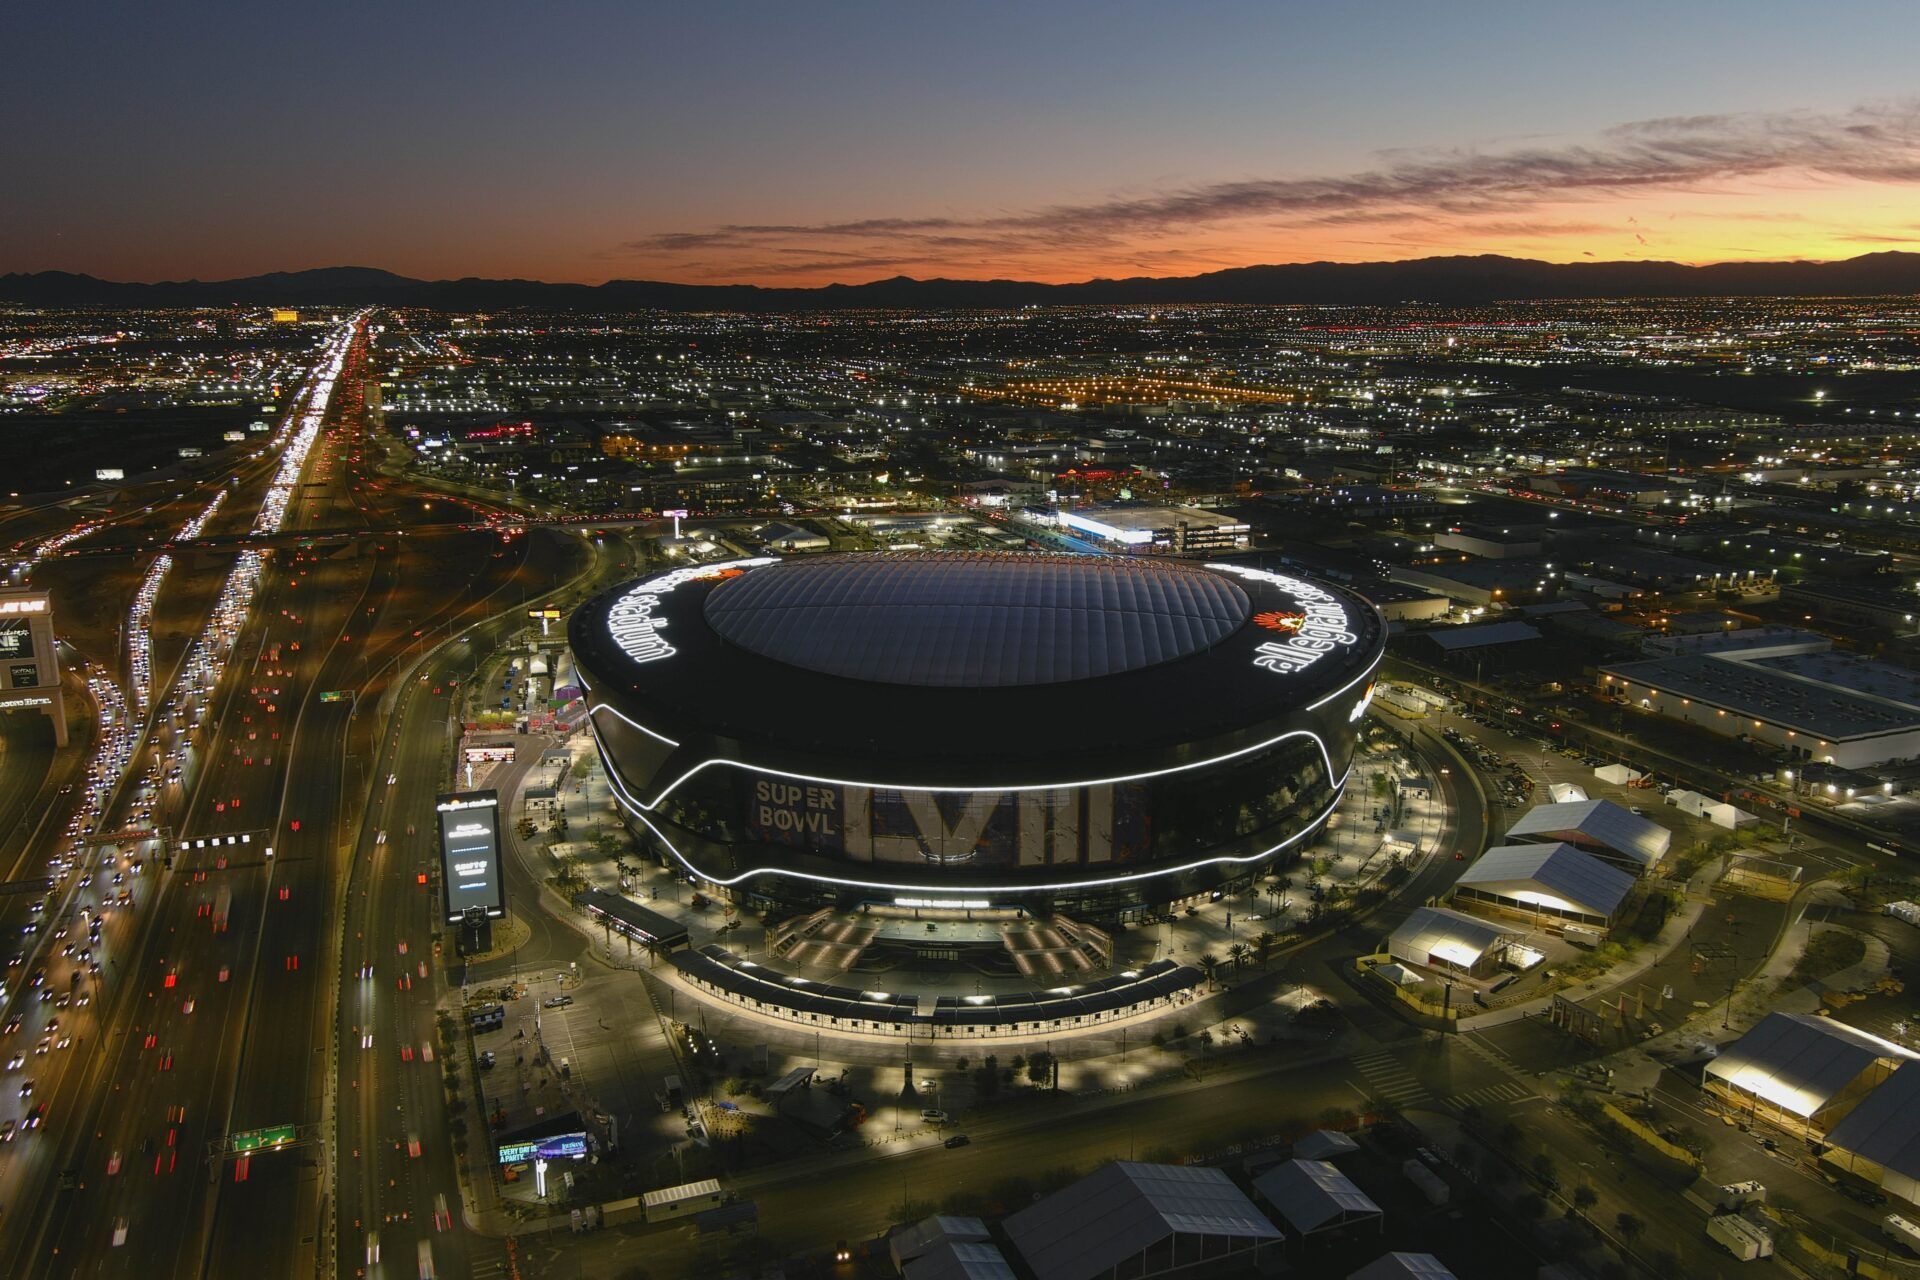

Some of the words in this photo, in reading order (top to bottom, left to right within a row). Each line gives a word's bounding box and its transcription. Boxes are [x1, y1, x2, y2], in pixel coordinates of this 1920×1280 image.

[608, 594, 677, 663] stadium
[1253, 600, 1357, 673] allegiant
[756, 780, 836, 810] SUPER
[759, 805, 835, 835] BOWL
[843, 785, 1113, 866] LVIII
[499, 1147, 518, 1156] EVERY
[519, 1146, 530, 1154] DAY
